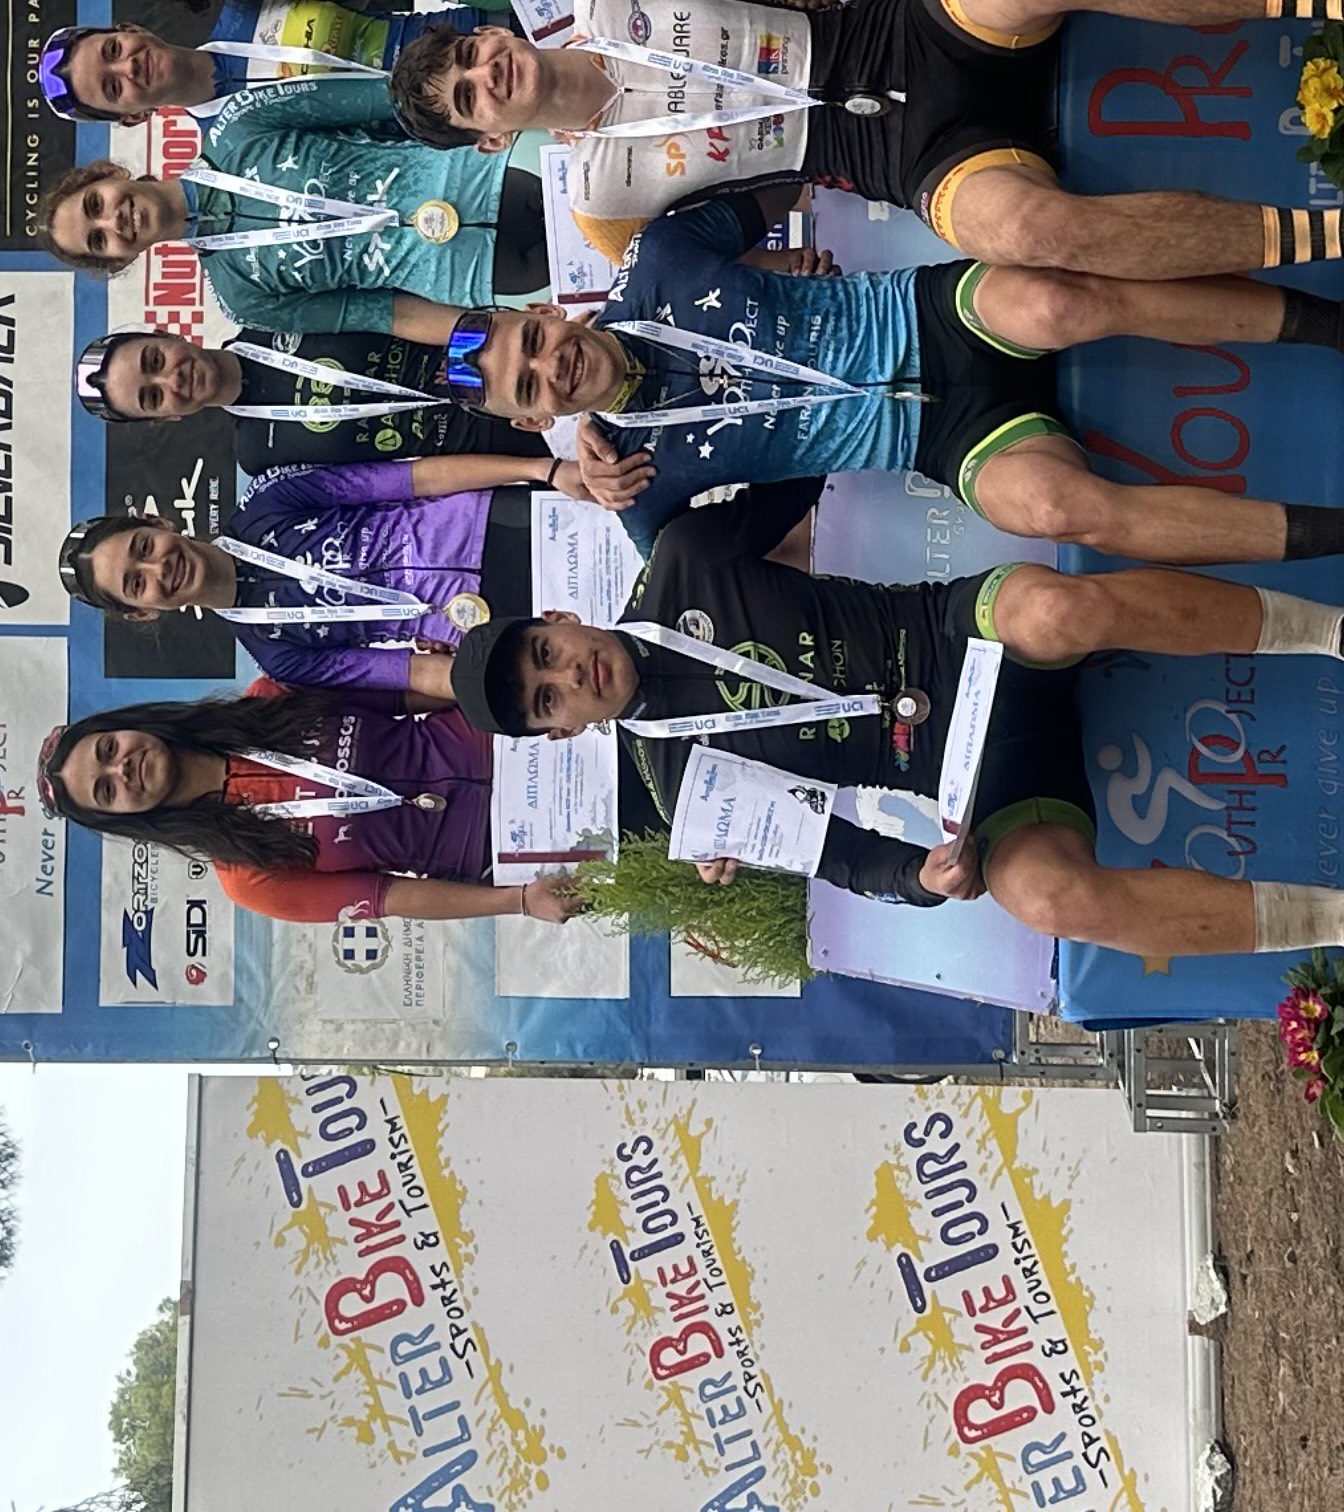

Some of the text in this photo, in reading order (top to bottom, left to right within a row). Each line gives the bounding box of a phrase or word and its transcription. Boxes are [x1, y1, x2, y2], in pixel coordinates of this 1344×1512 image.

[26, 38, 40, 84] OUR
[26, 98, 40, 119] IS
[25, 133, 40, 237] CYCLING
[774, 315, 791, 335] up
[567, 531, 579, 600] ΔΙΠΛΩΜΑ
[526, 742, 541, 809] ΔΙΠΛΩΜΑ
[35, 827, 56, 897] Never
[413, 1230, 440, 1250] &
[609, 1134, 685, 1284] TOURS
[897, 1112, 999, 1313] TOURS
[324, 1169, 425, 1336] BIKE
[648, 1254, 724, 1381] BIKE
[715, 1302, 735, 1317] &
[952, 1274, 1055, 1445] BIKE
[1042, 1338, 1069, 1358] &
